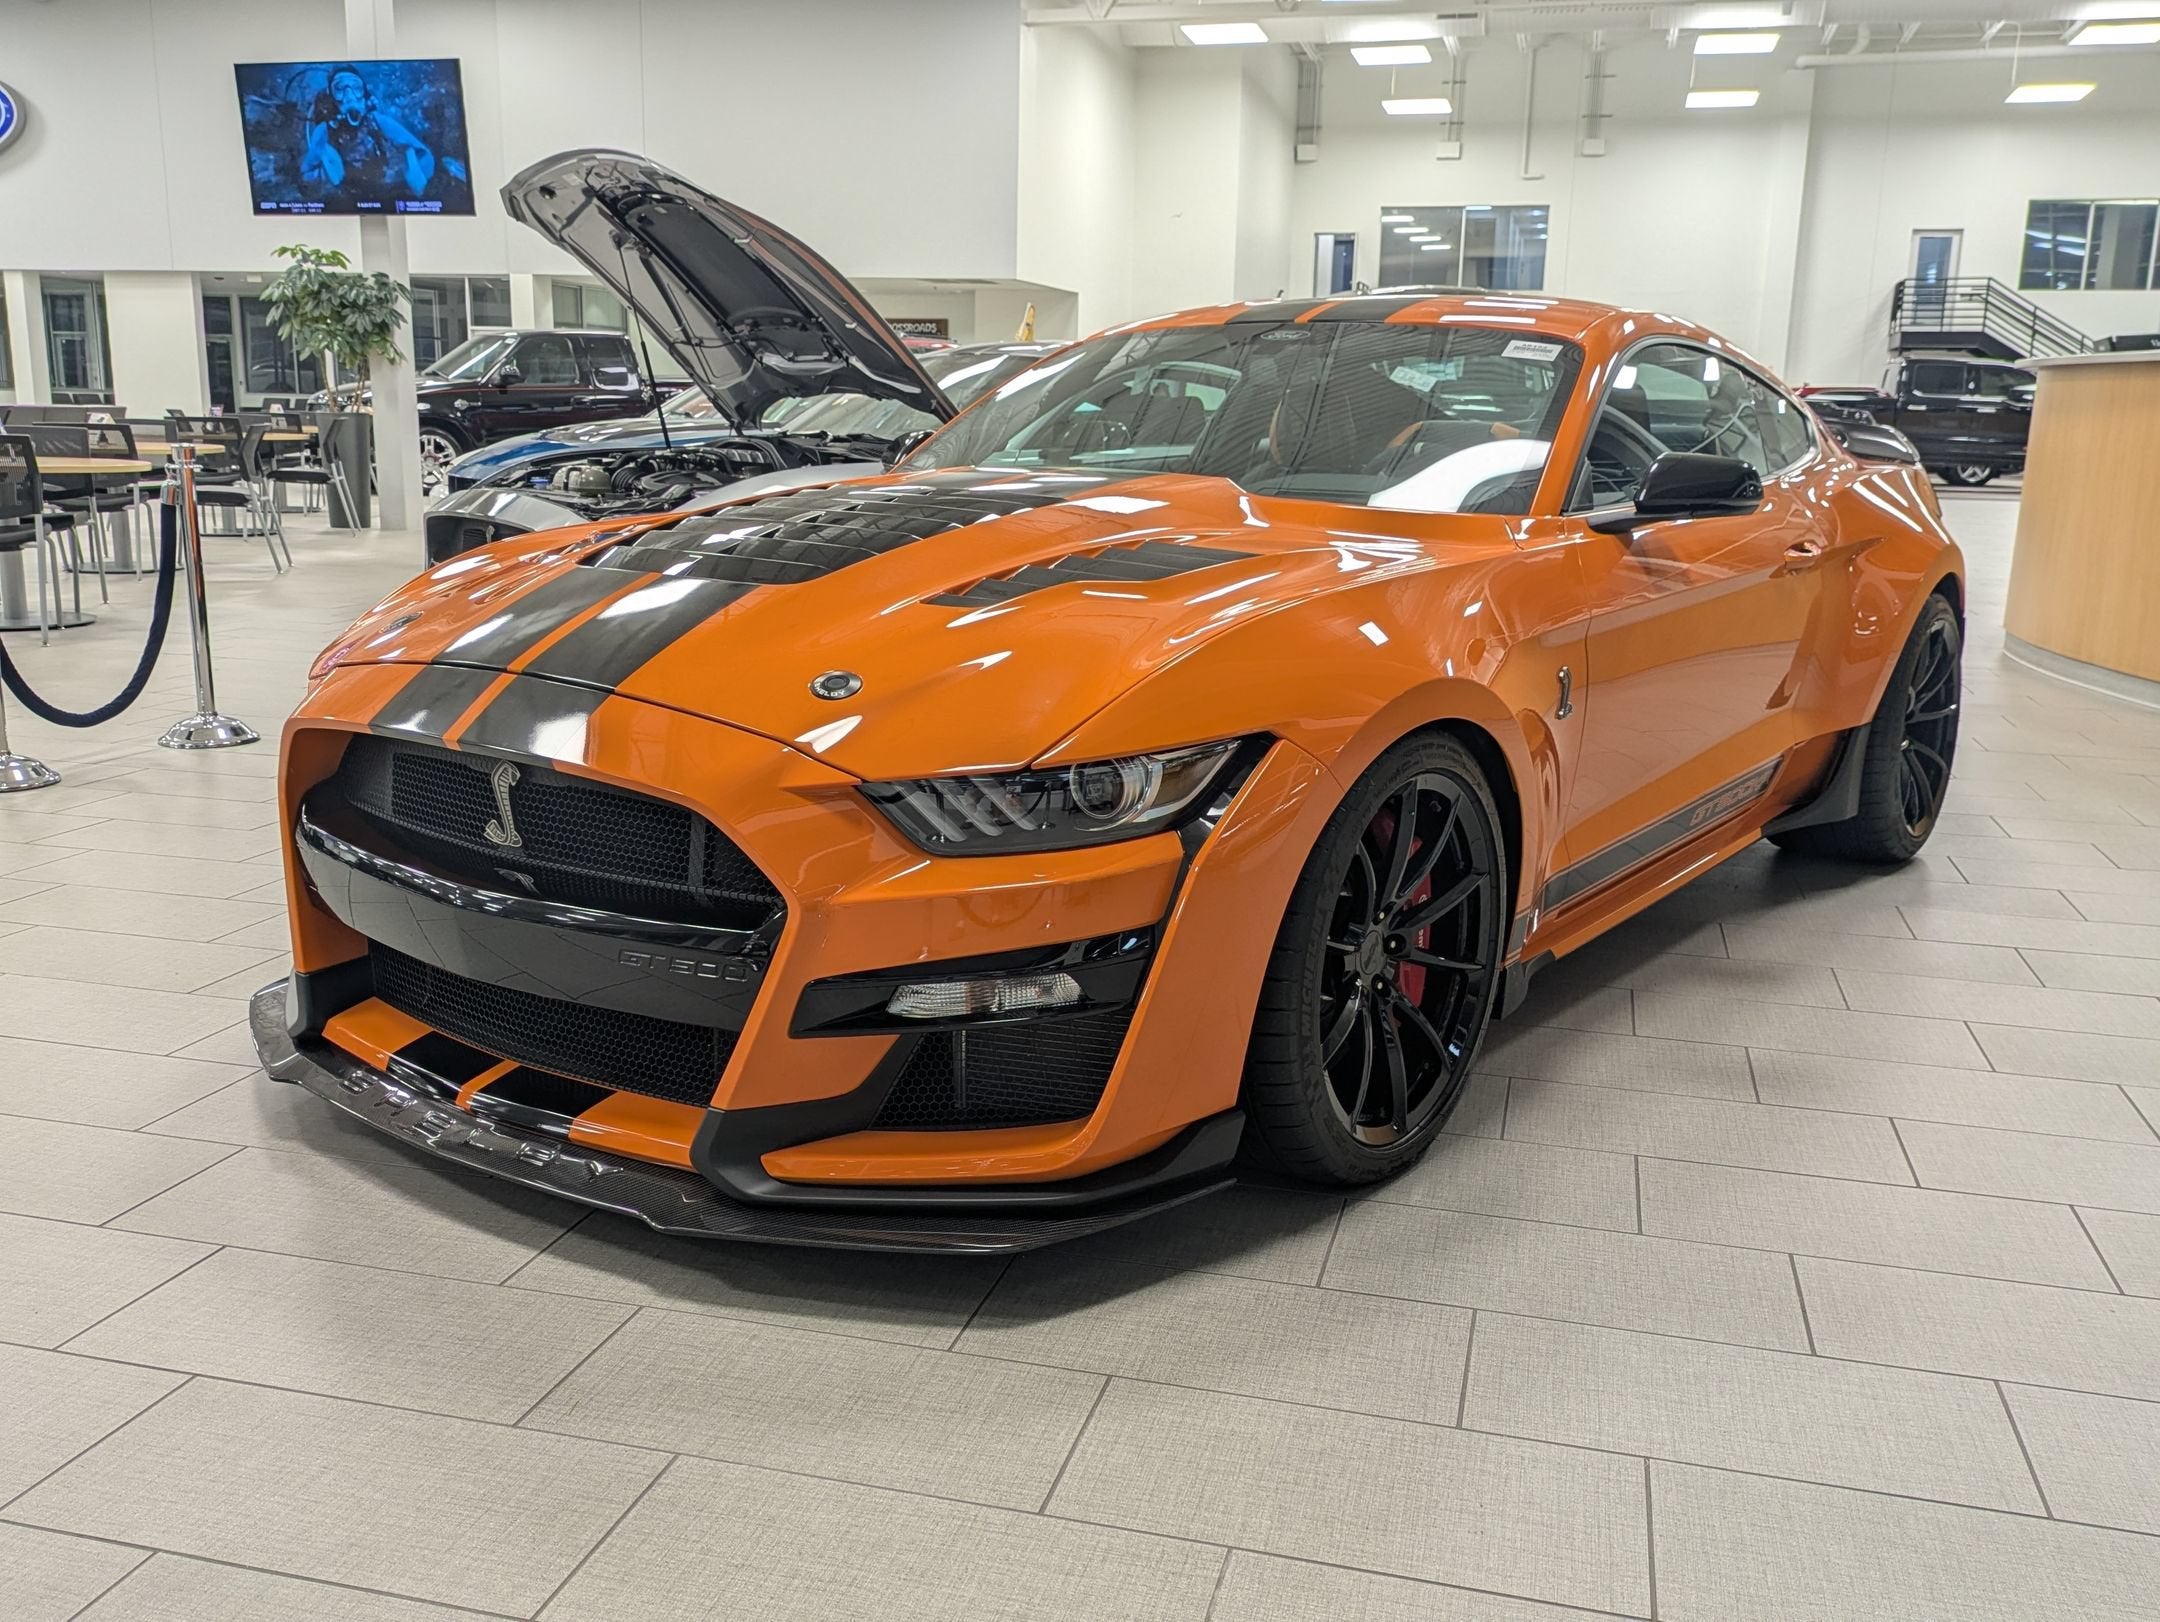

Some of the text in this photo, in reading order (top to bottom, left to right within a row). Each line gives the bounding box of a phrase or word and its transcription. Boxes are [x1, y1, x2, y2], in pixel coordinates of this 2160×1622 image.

[891, 322, 938, 333] OSSROADS
[814, 682, 846, 697] SHELBY
[618, 948, 750, 983] GT500
[1301, 911, 1326, 1037] MICHELIN
[337, 1068, 626, 1182] SHELBY
